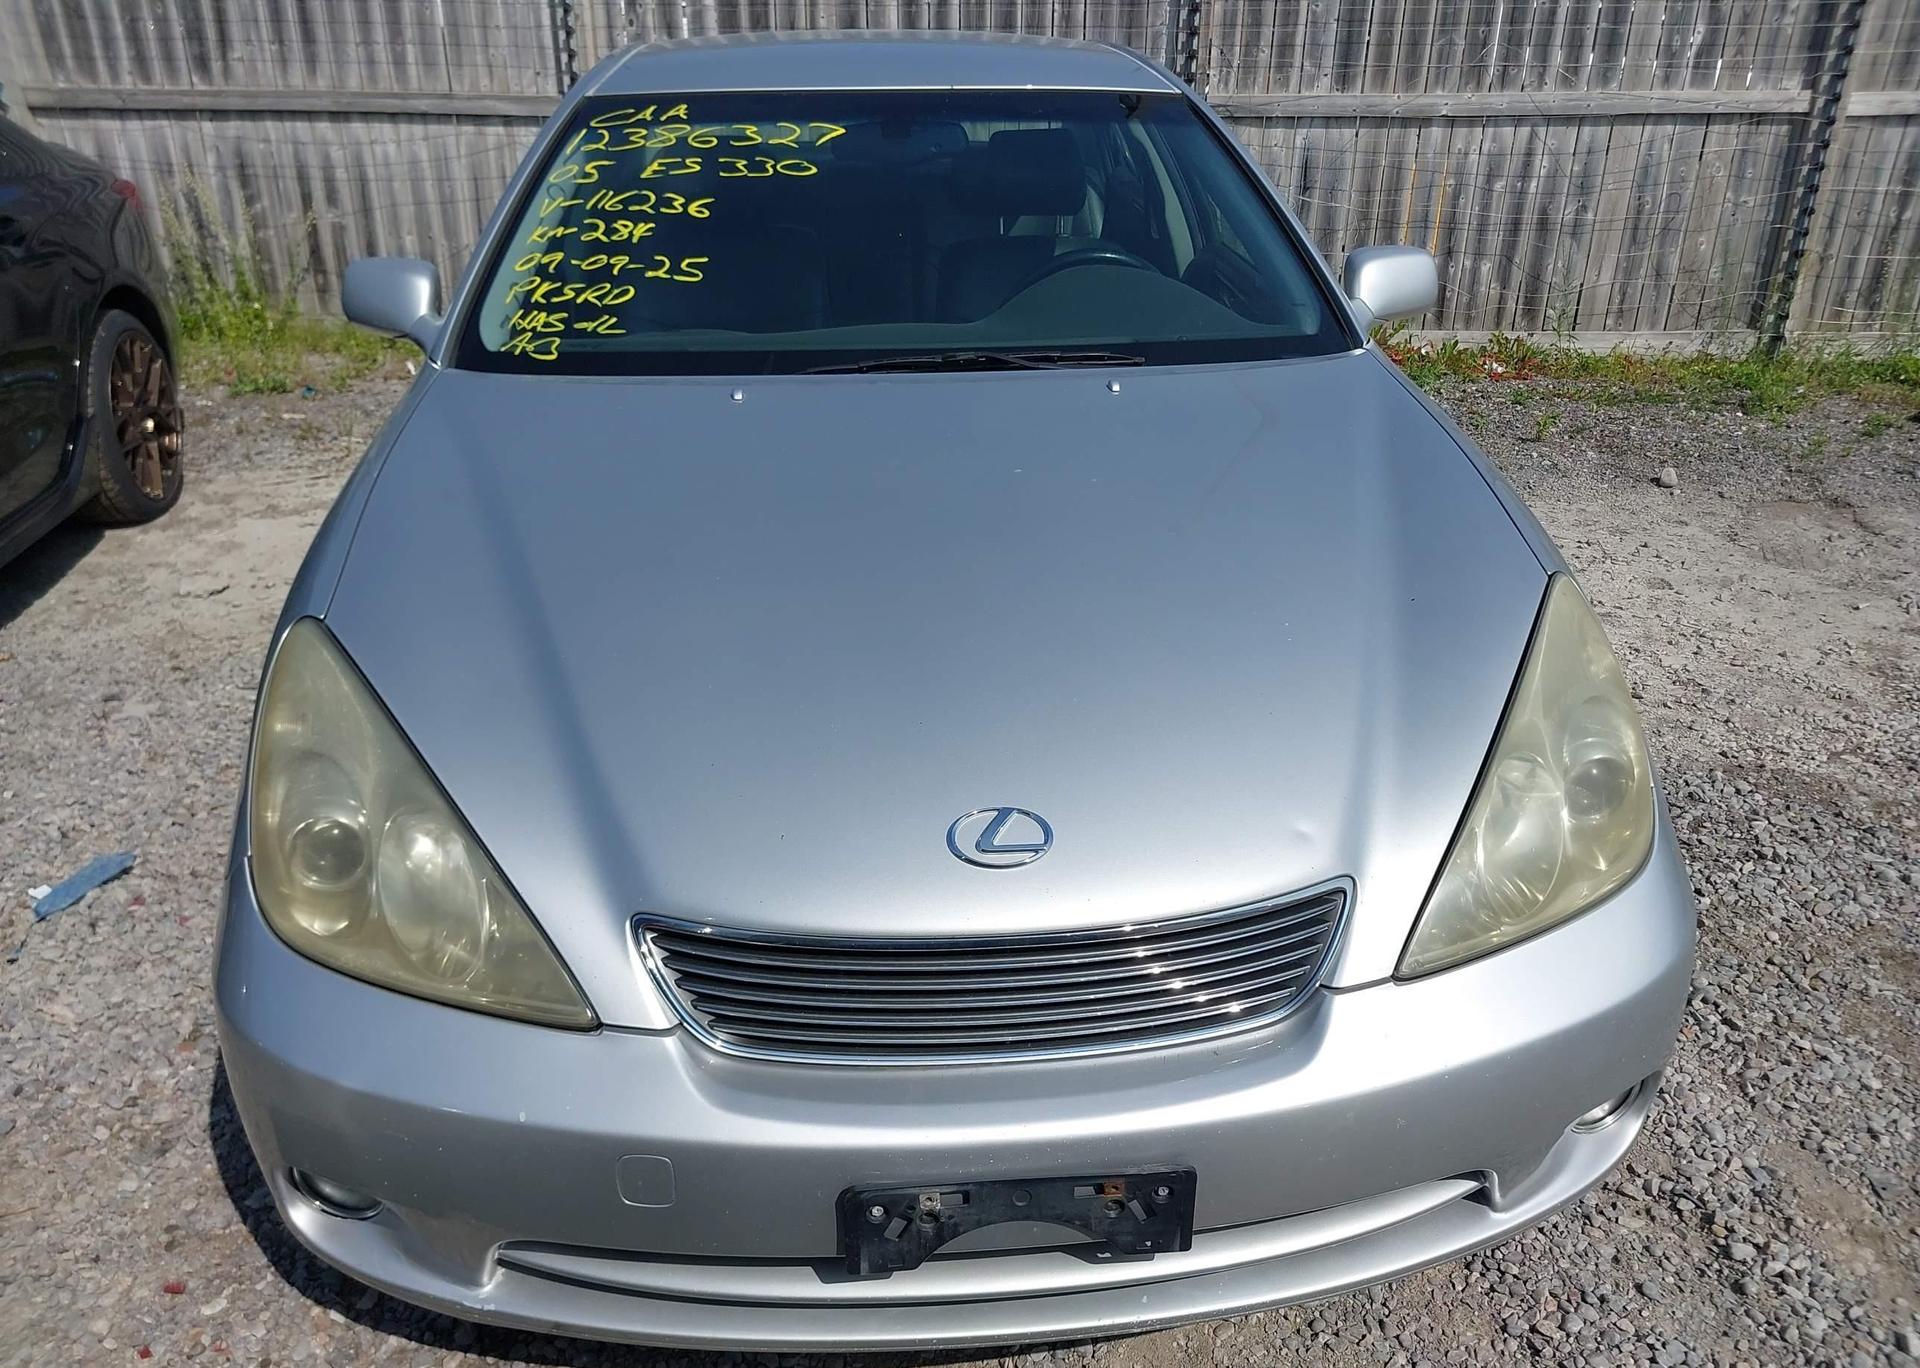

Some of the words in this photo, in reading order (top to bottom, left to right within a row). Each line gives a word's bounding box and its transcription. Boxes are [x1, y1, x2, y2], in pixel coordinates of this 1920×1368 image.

[566, 123, 847, 154] 12386327
[549, 160, 616, 184] 05
[640, 158, 703, 179] ES
[718, 157, 819, 178] 330
[513, 252, 710, 282] 09-09-25
